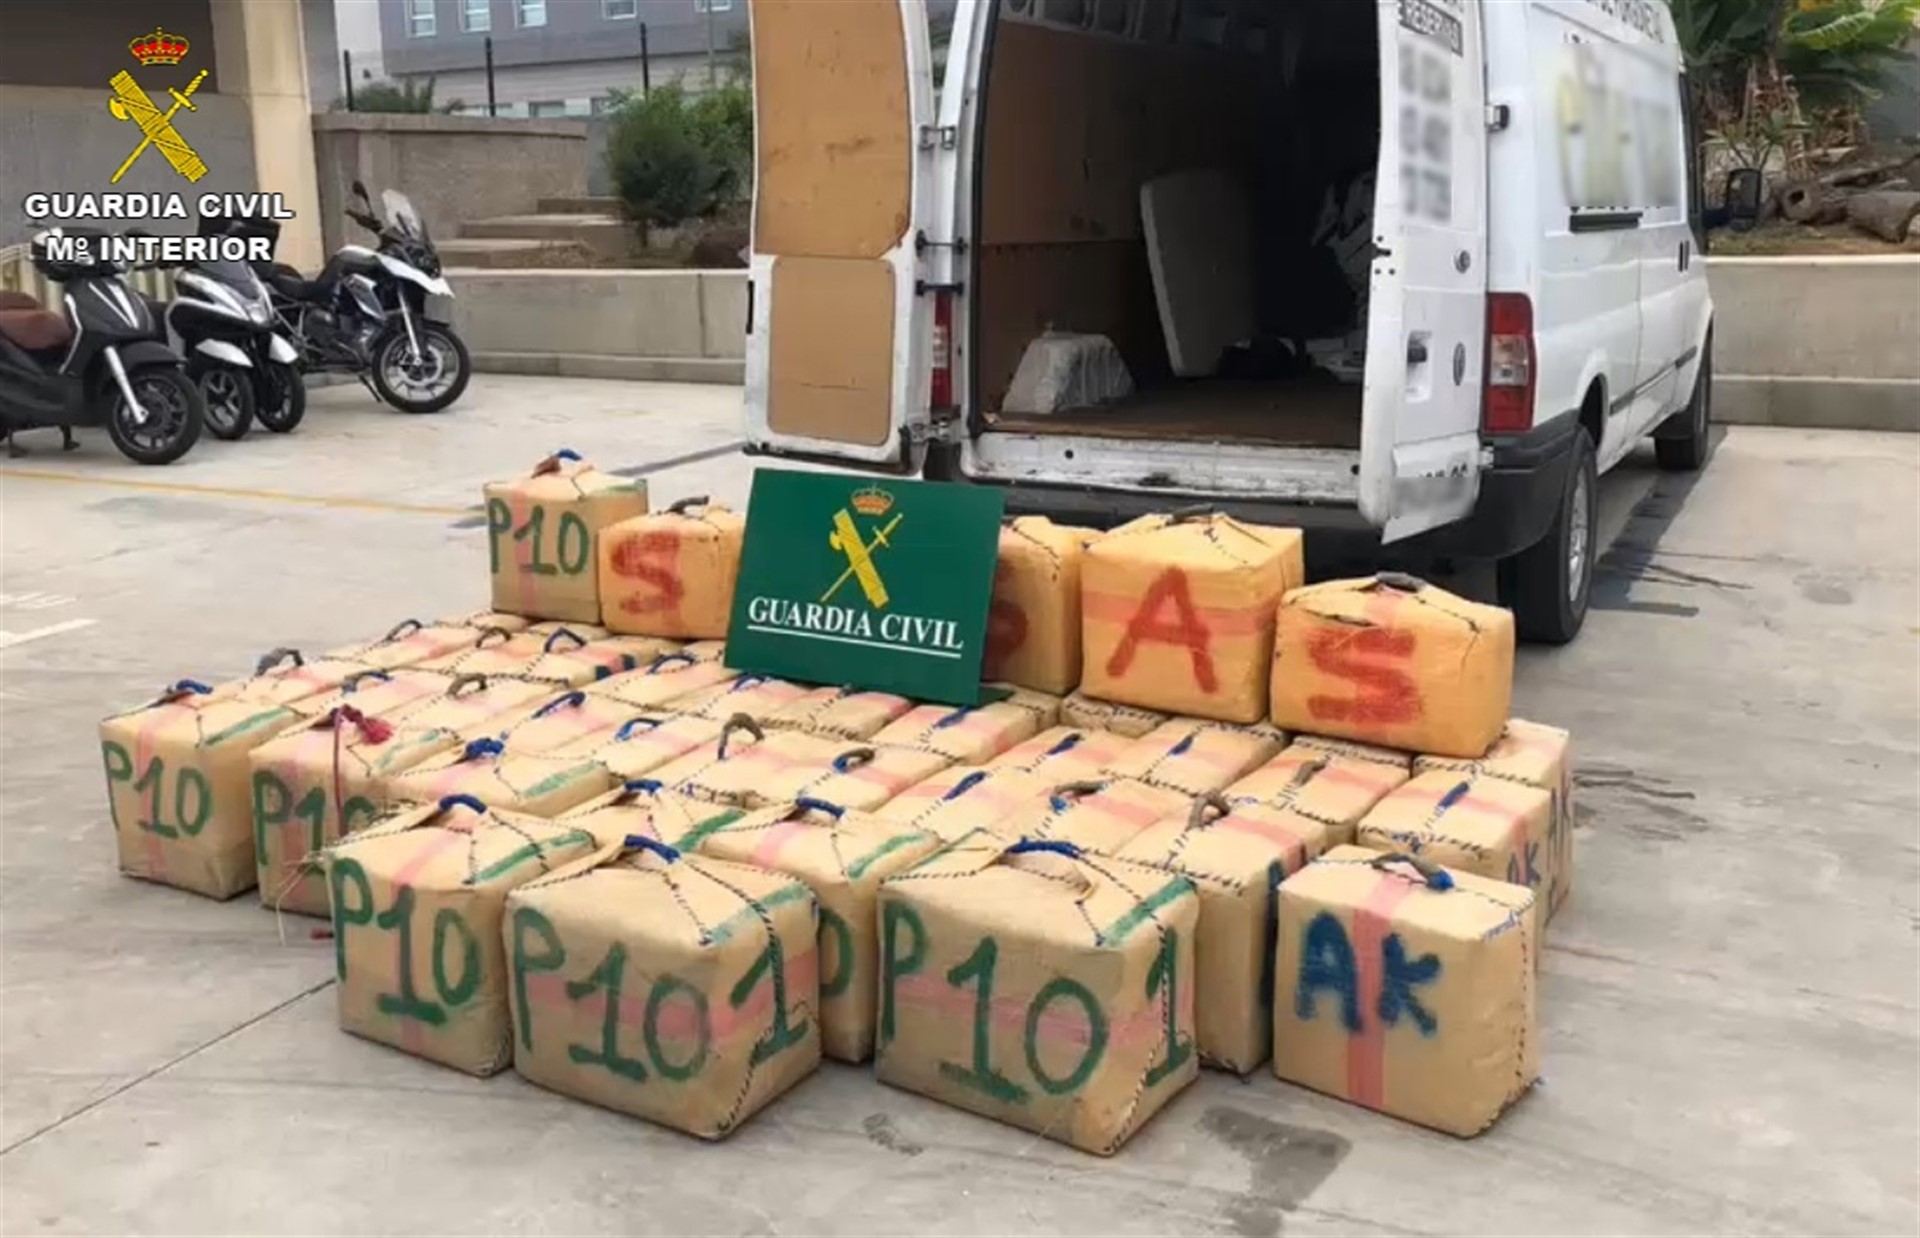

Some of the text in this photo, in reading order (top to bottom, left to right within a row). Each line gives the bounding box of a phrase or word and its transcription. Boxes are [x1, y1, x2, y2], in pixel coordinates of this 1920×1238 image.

[488, 497, 590, 576] P10
[610, 530, 685, 614] S
[748, 597, 964, 650] GUARDIA CIVIL
[1106, 566, 1218, 693] A
[1307, 625, 1422, 724] S
[102, 740, 212, 839] P10
[331, 857, 481, 1026] P10
[1295, 911, 1442, 1038] AK
